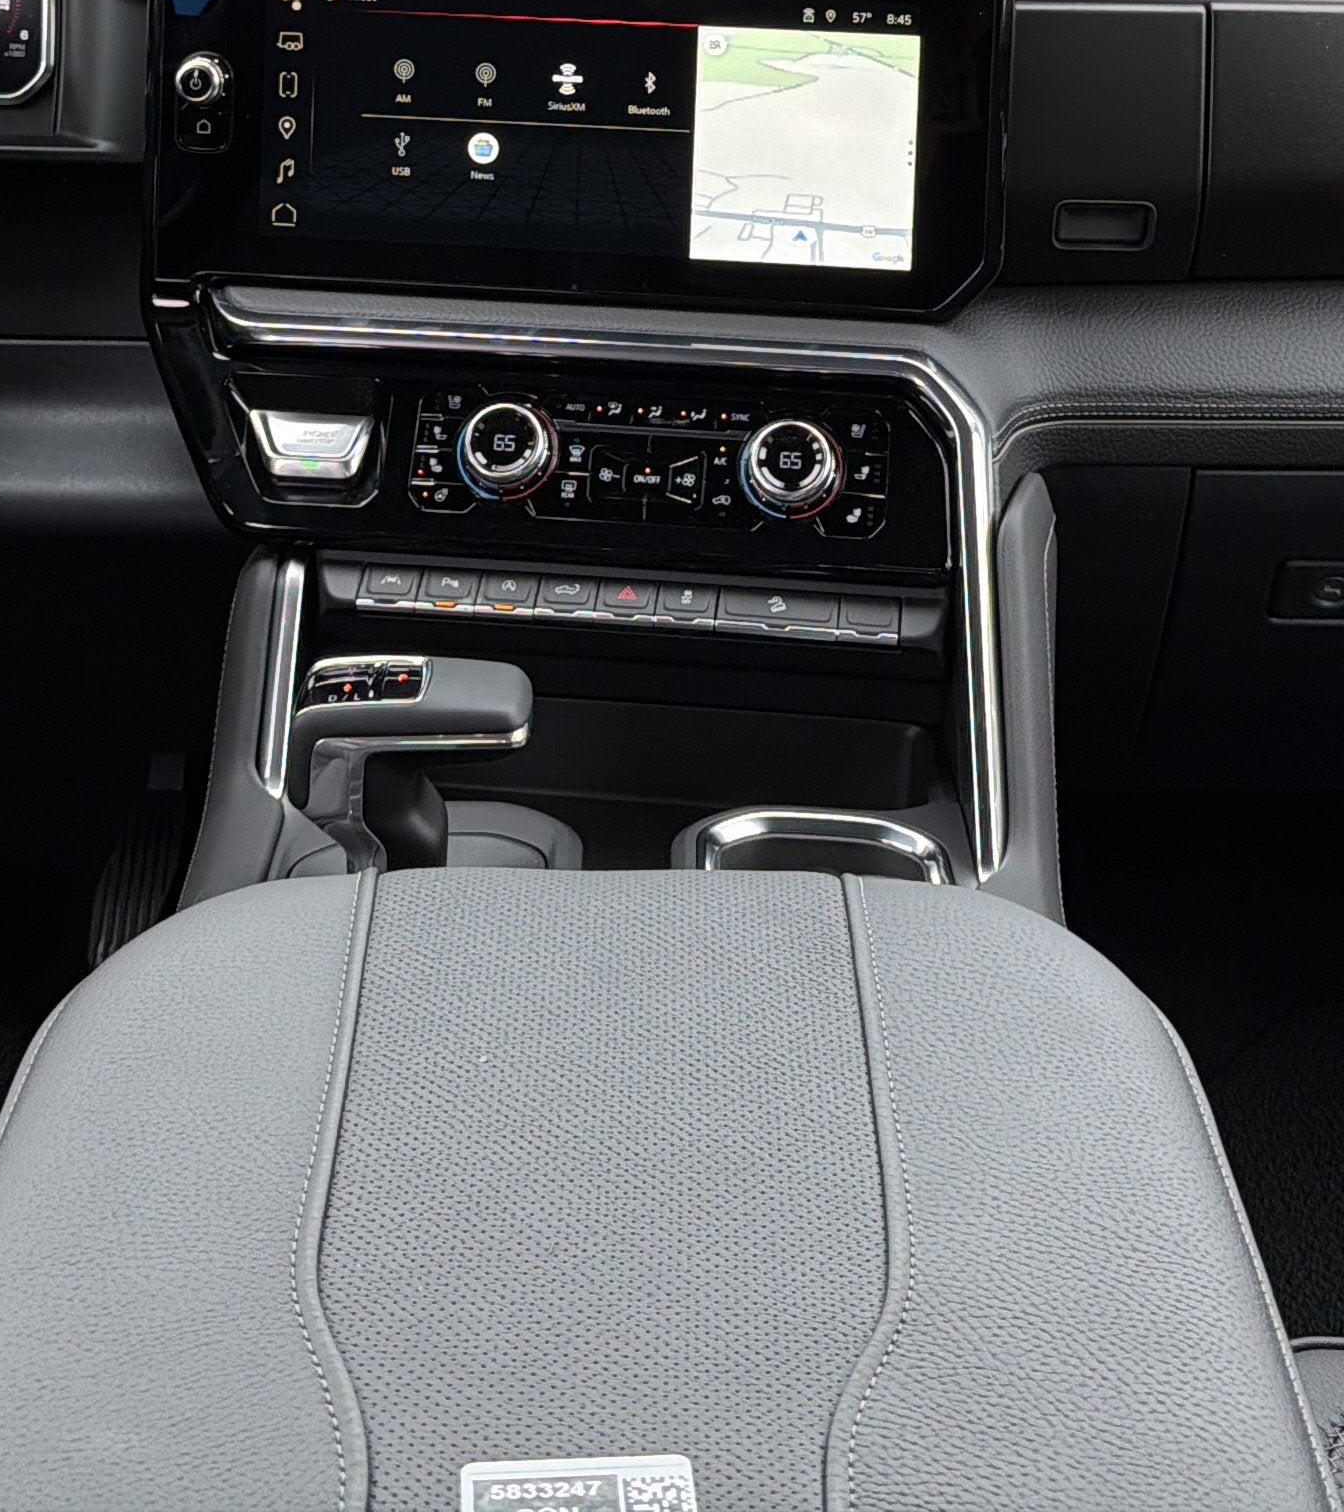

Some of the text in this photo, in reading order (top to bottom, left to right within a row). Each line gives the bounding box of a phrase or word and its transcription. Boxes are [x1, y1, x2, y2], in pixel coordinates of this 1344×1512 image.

[886, 13, 913, 26] 8:45
[395, 94, 412, 104] AM
[477, 98, 493, 108] FM
[547, 100, 586, 113] SiriusXM
[627, 104, 671, 117] Bluetooth
[391, 166, 411, 177] USB
[470, 170, 495, 182] News
[565, 403, 586, 412] AUTO
[730, 412, 751, 422] SYNC
[492, 434, 517, 452] 65
[713, 456, 729, 466] A/C
[779, 451, 803, 470] 65
[633, 474, 661, 484] ON/OFF
[490, 1480, 603, 1501] 5833247
